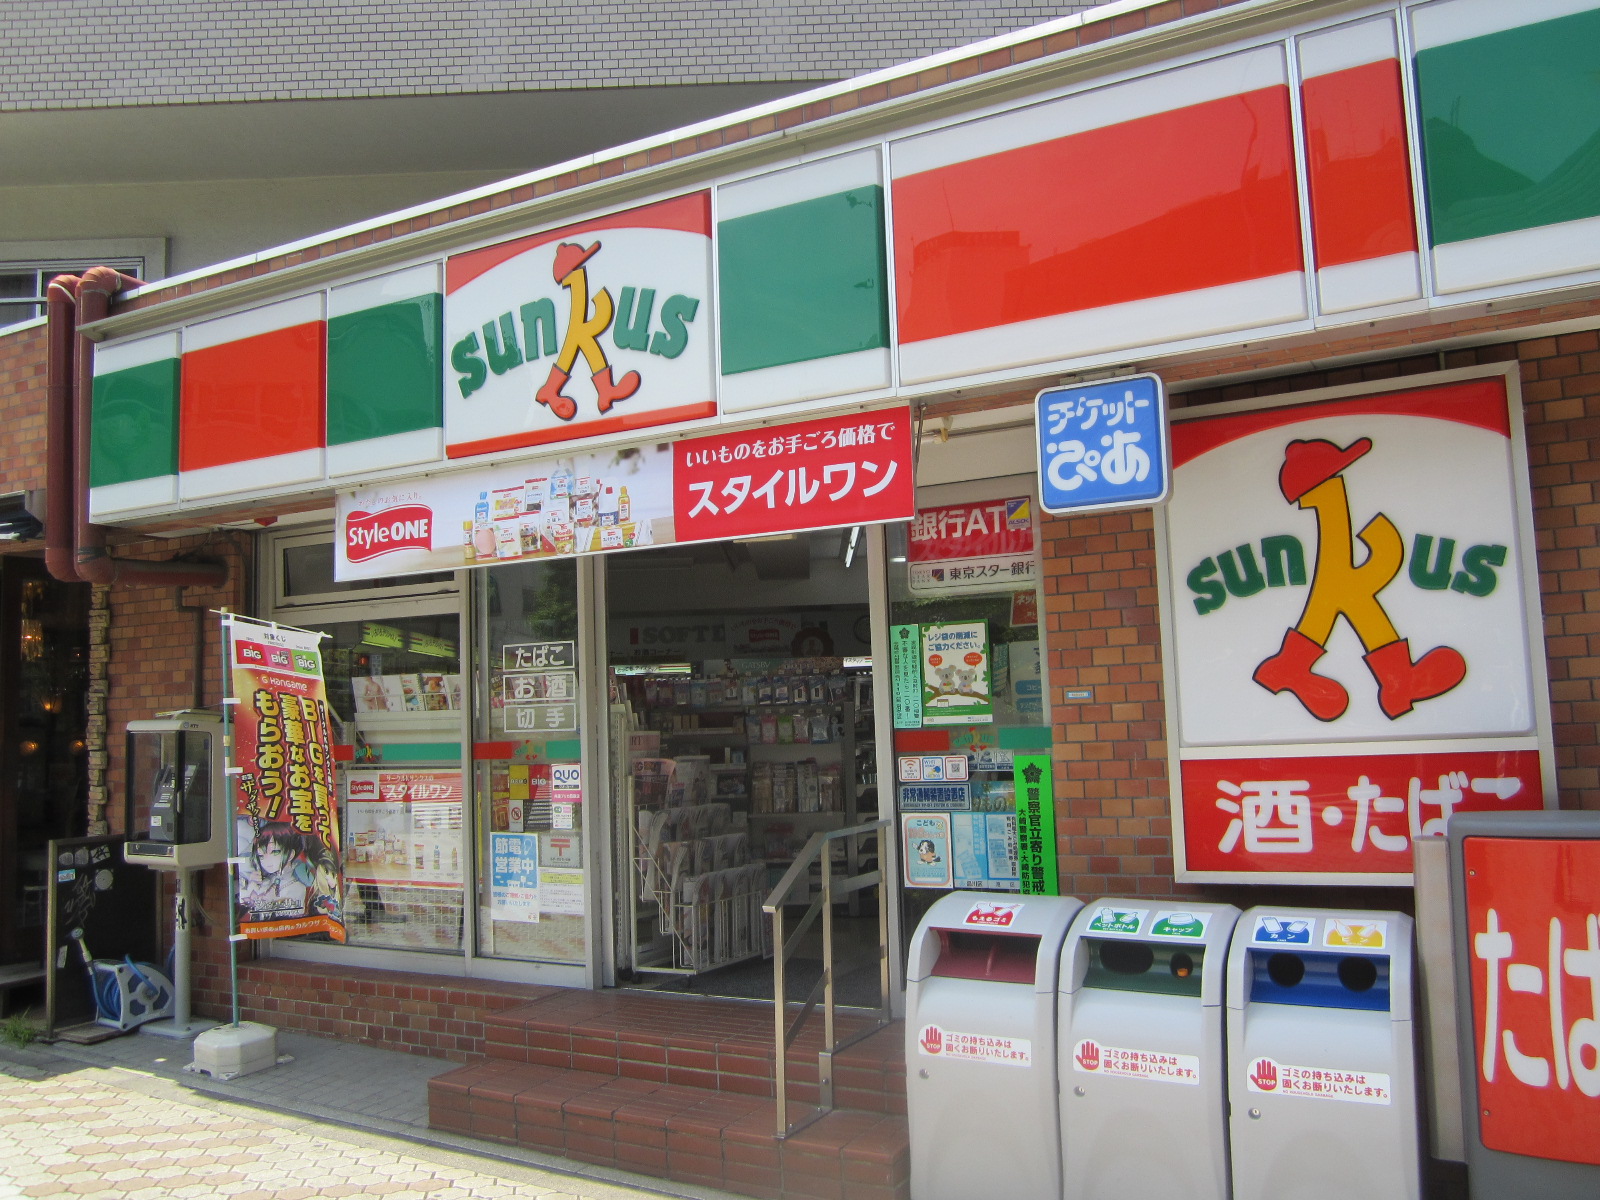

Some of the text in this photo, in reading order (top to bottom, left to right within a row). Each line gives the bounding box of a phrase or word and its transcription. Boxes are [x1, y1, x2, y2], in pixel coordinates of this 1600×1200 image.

[1048, 390, 1150, 434] チケット
[686, 422, 896, 468] いいものをお手ごろ価格で
[1046, 430, 1150, 491] ぴあ
[688, 460, 898, 519] スタイルワン
[911, 504, 1029, 542] 銀行AT
[515, 646, 565, 668] たばこ
[514, 675, 567, 698] お酒
[516, 706, 566, 729] 切手
[256, 690, 284, 818] もらおう！
[280, 693, 314, 833] 豪華なお宝を
[554, 770, 580, 784] QUO
[386, 784, 453, 799] スタイルワン
[916, 819, 936, 827] こども
[1027, 787, 1046, 894] 警察官立寄り警戒
[495, 856, 534, 874] 営業中
[1162, 926, 1194, 934] キャップ
[946, 1033, 1012, 1049] ゴミの持ち込みは
[946, 1044, 1030, 1062] 固くお断りいたします。
[1104, 1048, 1178, 1066] ゴミの持ち込みは
[1104, 1060, 1198, 1080] 固くお断りいたします。
[1282, 1067, 1366, 1084] ゴミの持ち込みは
[1258, 1078, 1276, 1086] STOP
[1282, 1078, 1388, 1098] 固くお断りいたします。
